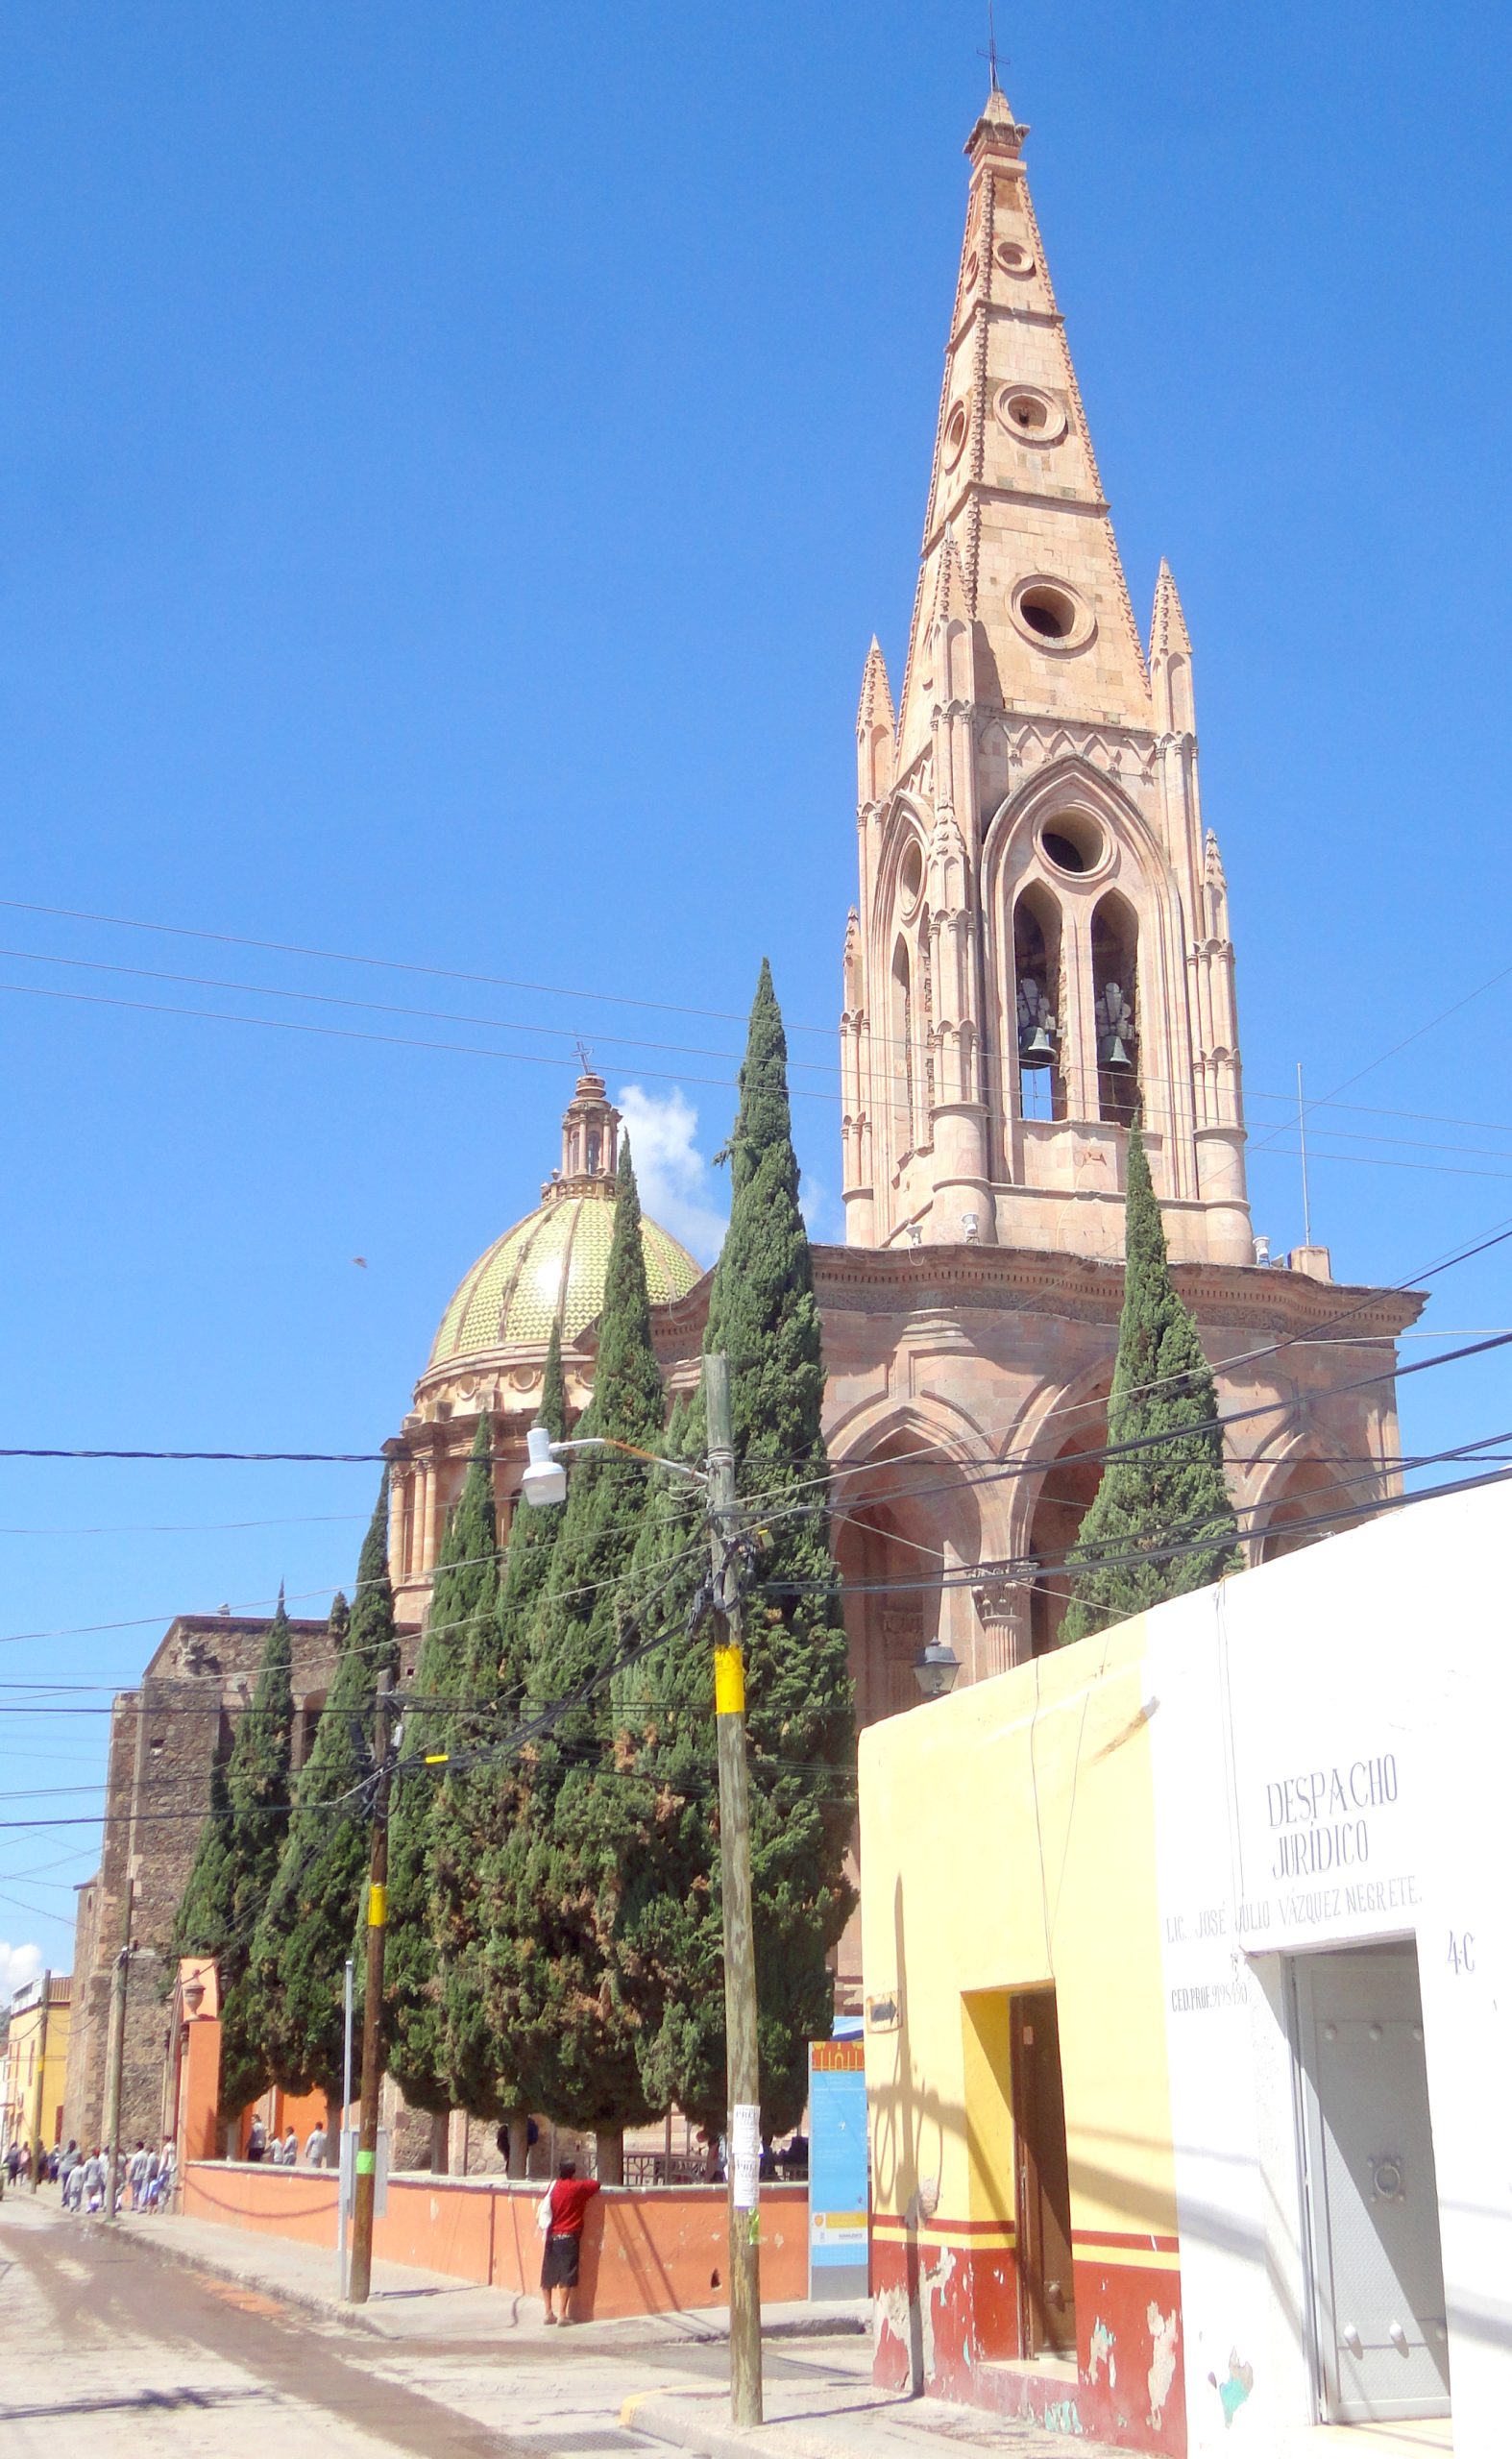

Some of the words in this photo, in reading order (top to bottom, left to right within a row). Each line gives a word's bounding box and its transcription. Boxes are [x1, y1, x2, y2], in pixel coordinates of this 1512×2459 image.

[1266, 1753, 1398, 1829] DESPACHO
[1273, 1820, 1369, 1880] JURÍDICO
[1194, 1901, 1227, 1938] JOSÉ
[1234, 1900, 1270, 1934] JULIO
[1278, 1887, 1342, 1926] VÁZQUEZ
